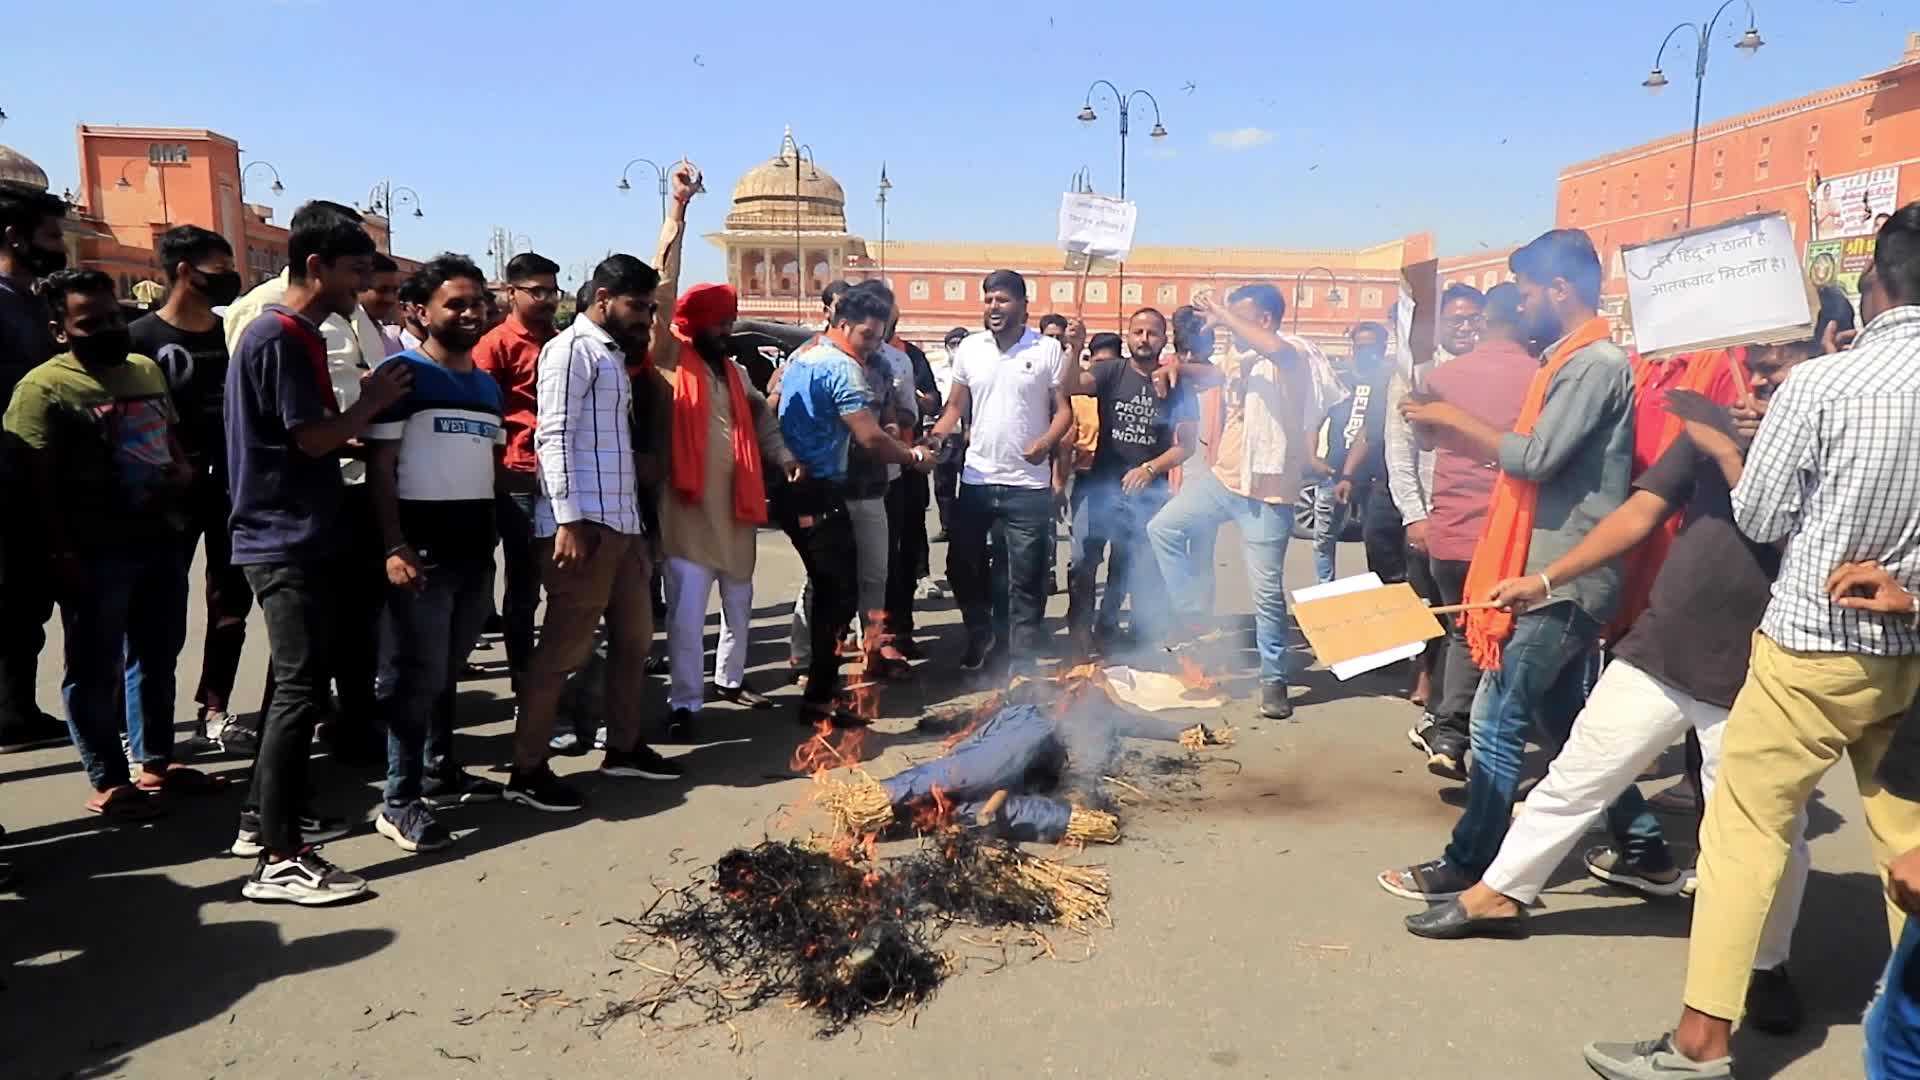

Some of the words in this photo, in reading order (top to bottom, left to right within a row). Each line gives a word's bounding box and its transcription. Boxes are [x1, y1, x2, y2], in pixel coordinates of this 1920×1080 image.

[1130, 395, 1153, 407] AM
[1117, 411, 1136, 423] TO
[1112, 428, 1158, 445] INDIAN
